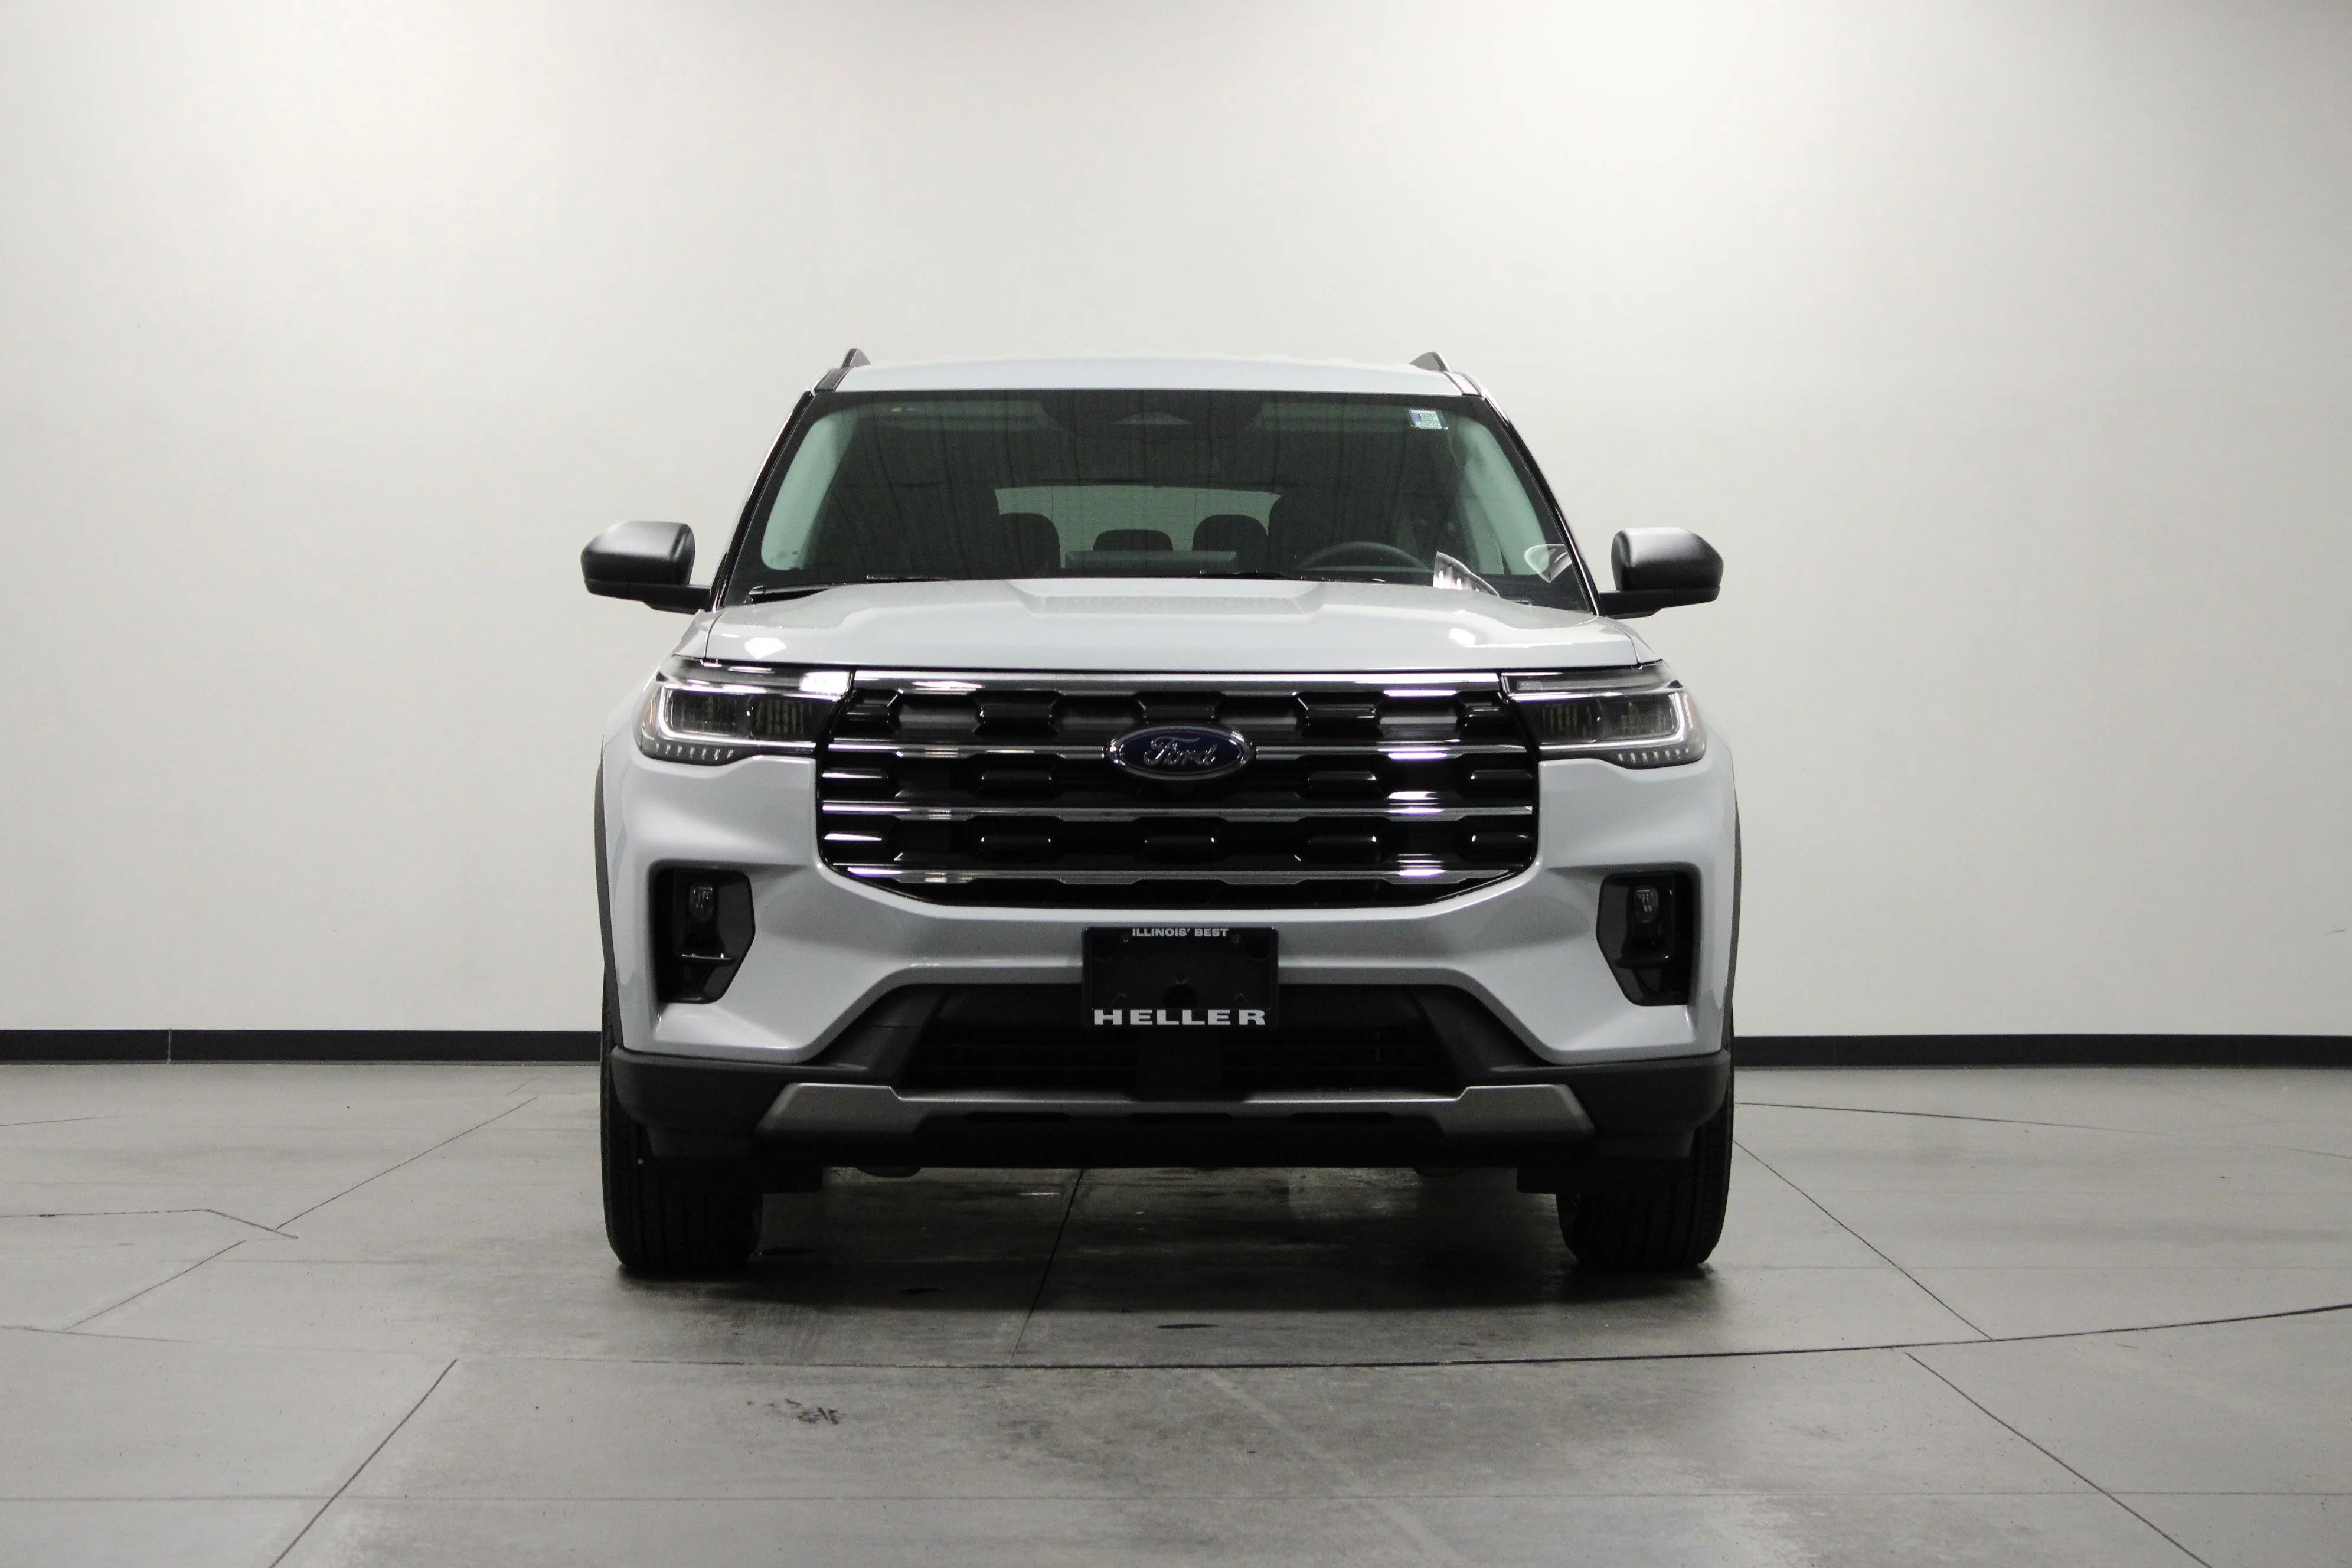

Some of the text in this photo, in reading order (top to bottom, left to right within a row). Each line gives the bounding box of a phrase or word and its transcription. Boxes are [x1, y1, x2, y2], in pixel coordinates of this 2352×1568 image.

[1144, 736, 1217, 766] Ford
[1132, 928, 1229, 937] ILLINOIS' BEST
[1094, 1009, 1266, 1025] HELLER
